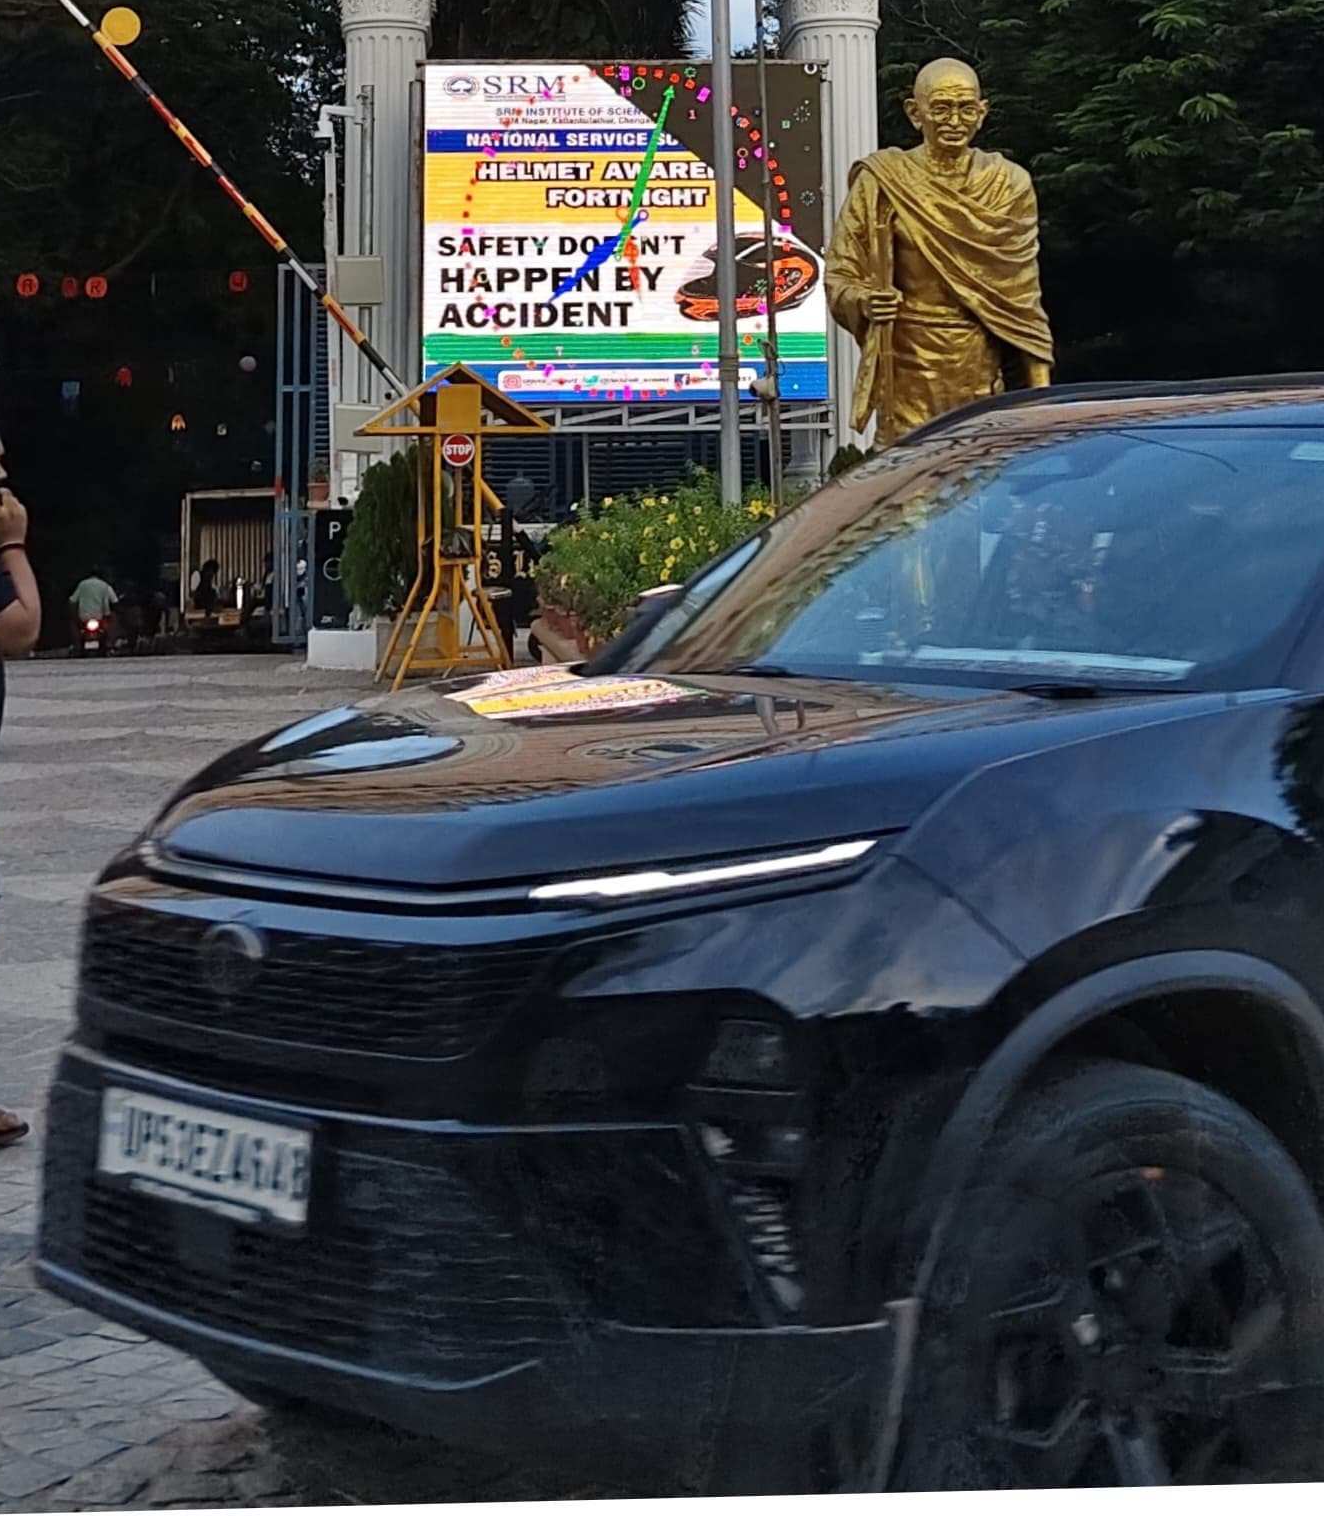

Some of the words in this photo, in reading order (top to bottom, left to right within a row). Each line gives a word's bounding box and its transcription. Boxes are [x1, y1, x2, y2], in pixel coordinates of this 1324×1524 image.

[483, 75, 566, 94] SRM
[526, 107, 584, 117] INSTITUTE
[588, 107, 603, 117] OF
[466, 132, 560, 147] NATIONAL
[566, 132, 648, 147] SERVICE
[477, 161, 593, 181] HELMET
[438, 236, 549, 256] SAFETY
[559, 236, 685, 256] DON'T
[440, 267, 600, 293] HAPPEN
[615, 267, 665, 292] BY
[439, 302, 633, 328] ACCIDENT
[445, 443, 473, 456] STOP
[329, 521, 341, 540] P
